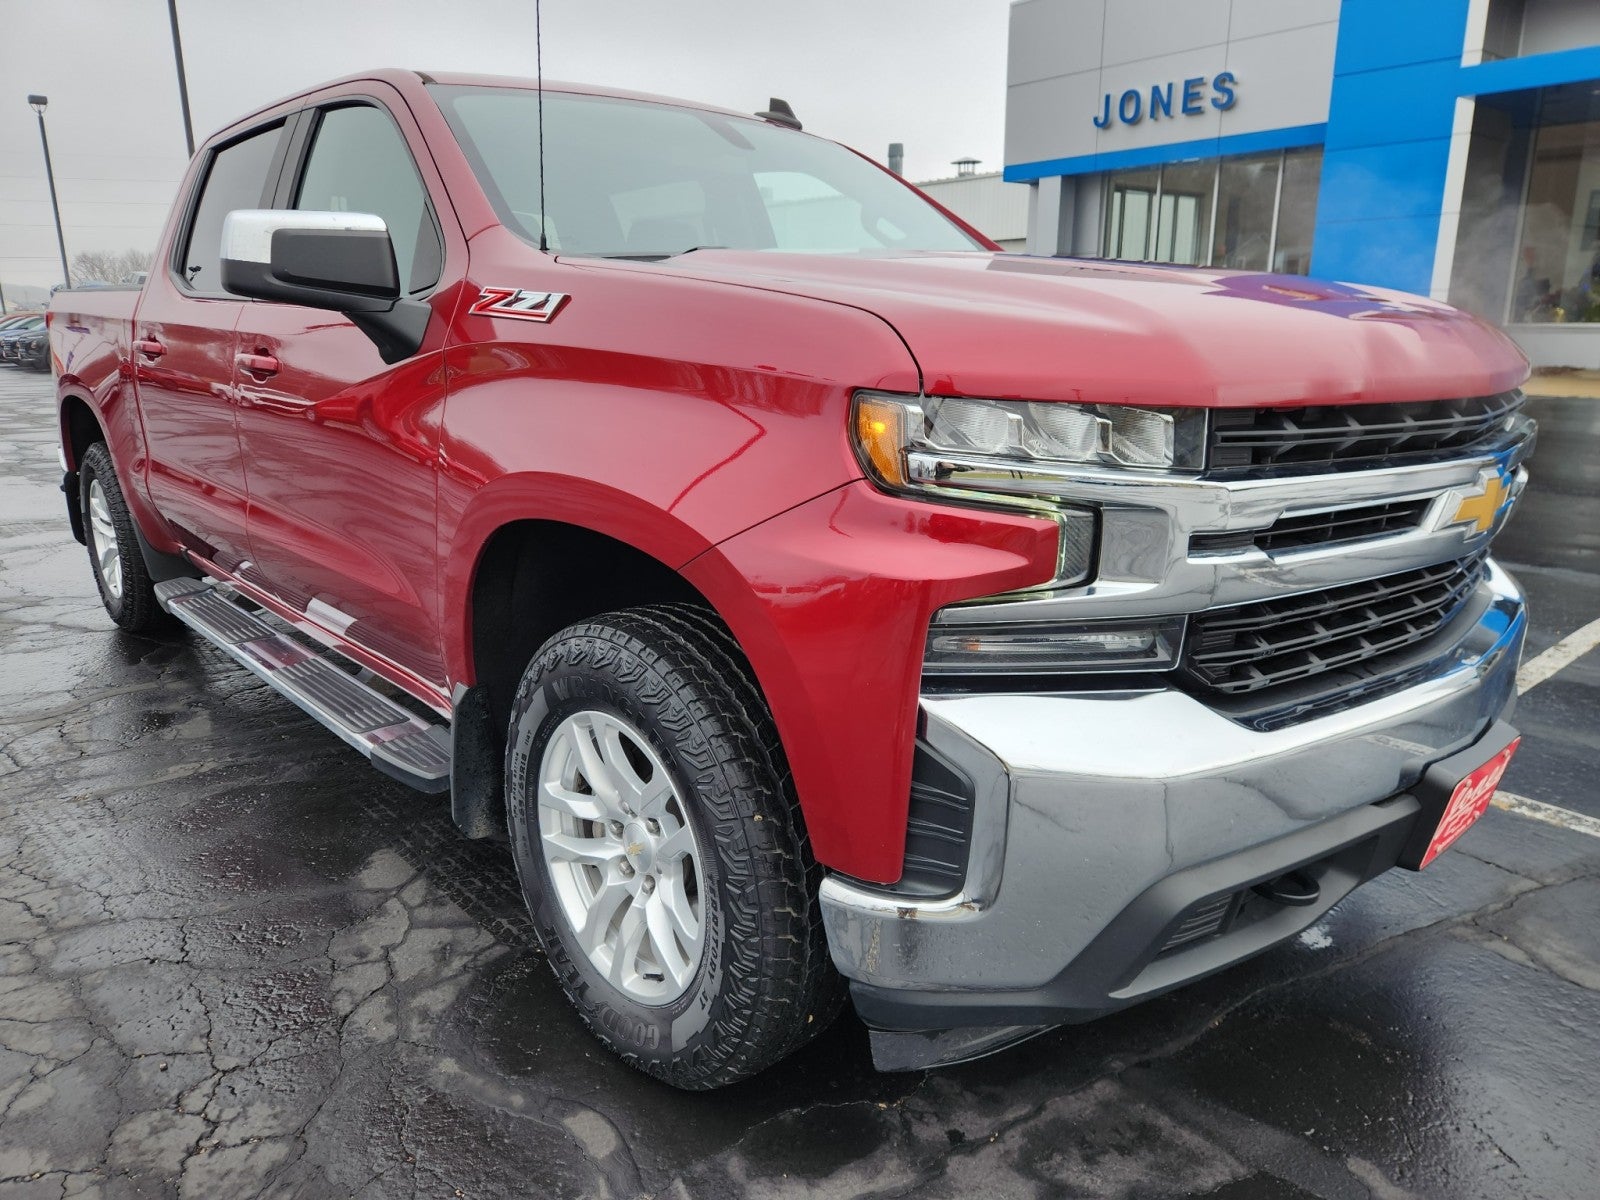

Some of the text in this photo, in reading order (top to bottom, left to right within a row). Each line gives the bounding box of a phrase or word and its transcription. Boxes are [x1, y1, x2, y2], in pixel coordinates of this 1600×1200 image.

[1093, 72, 1236, 128] JONES
[469, 286, 564, 322] Z71
[707, 873, 719, 984] TERRITORY
